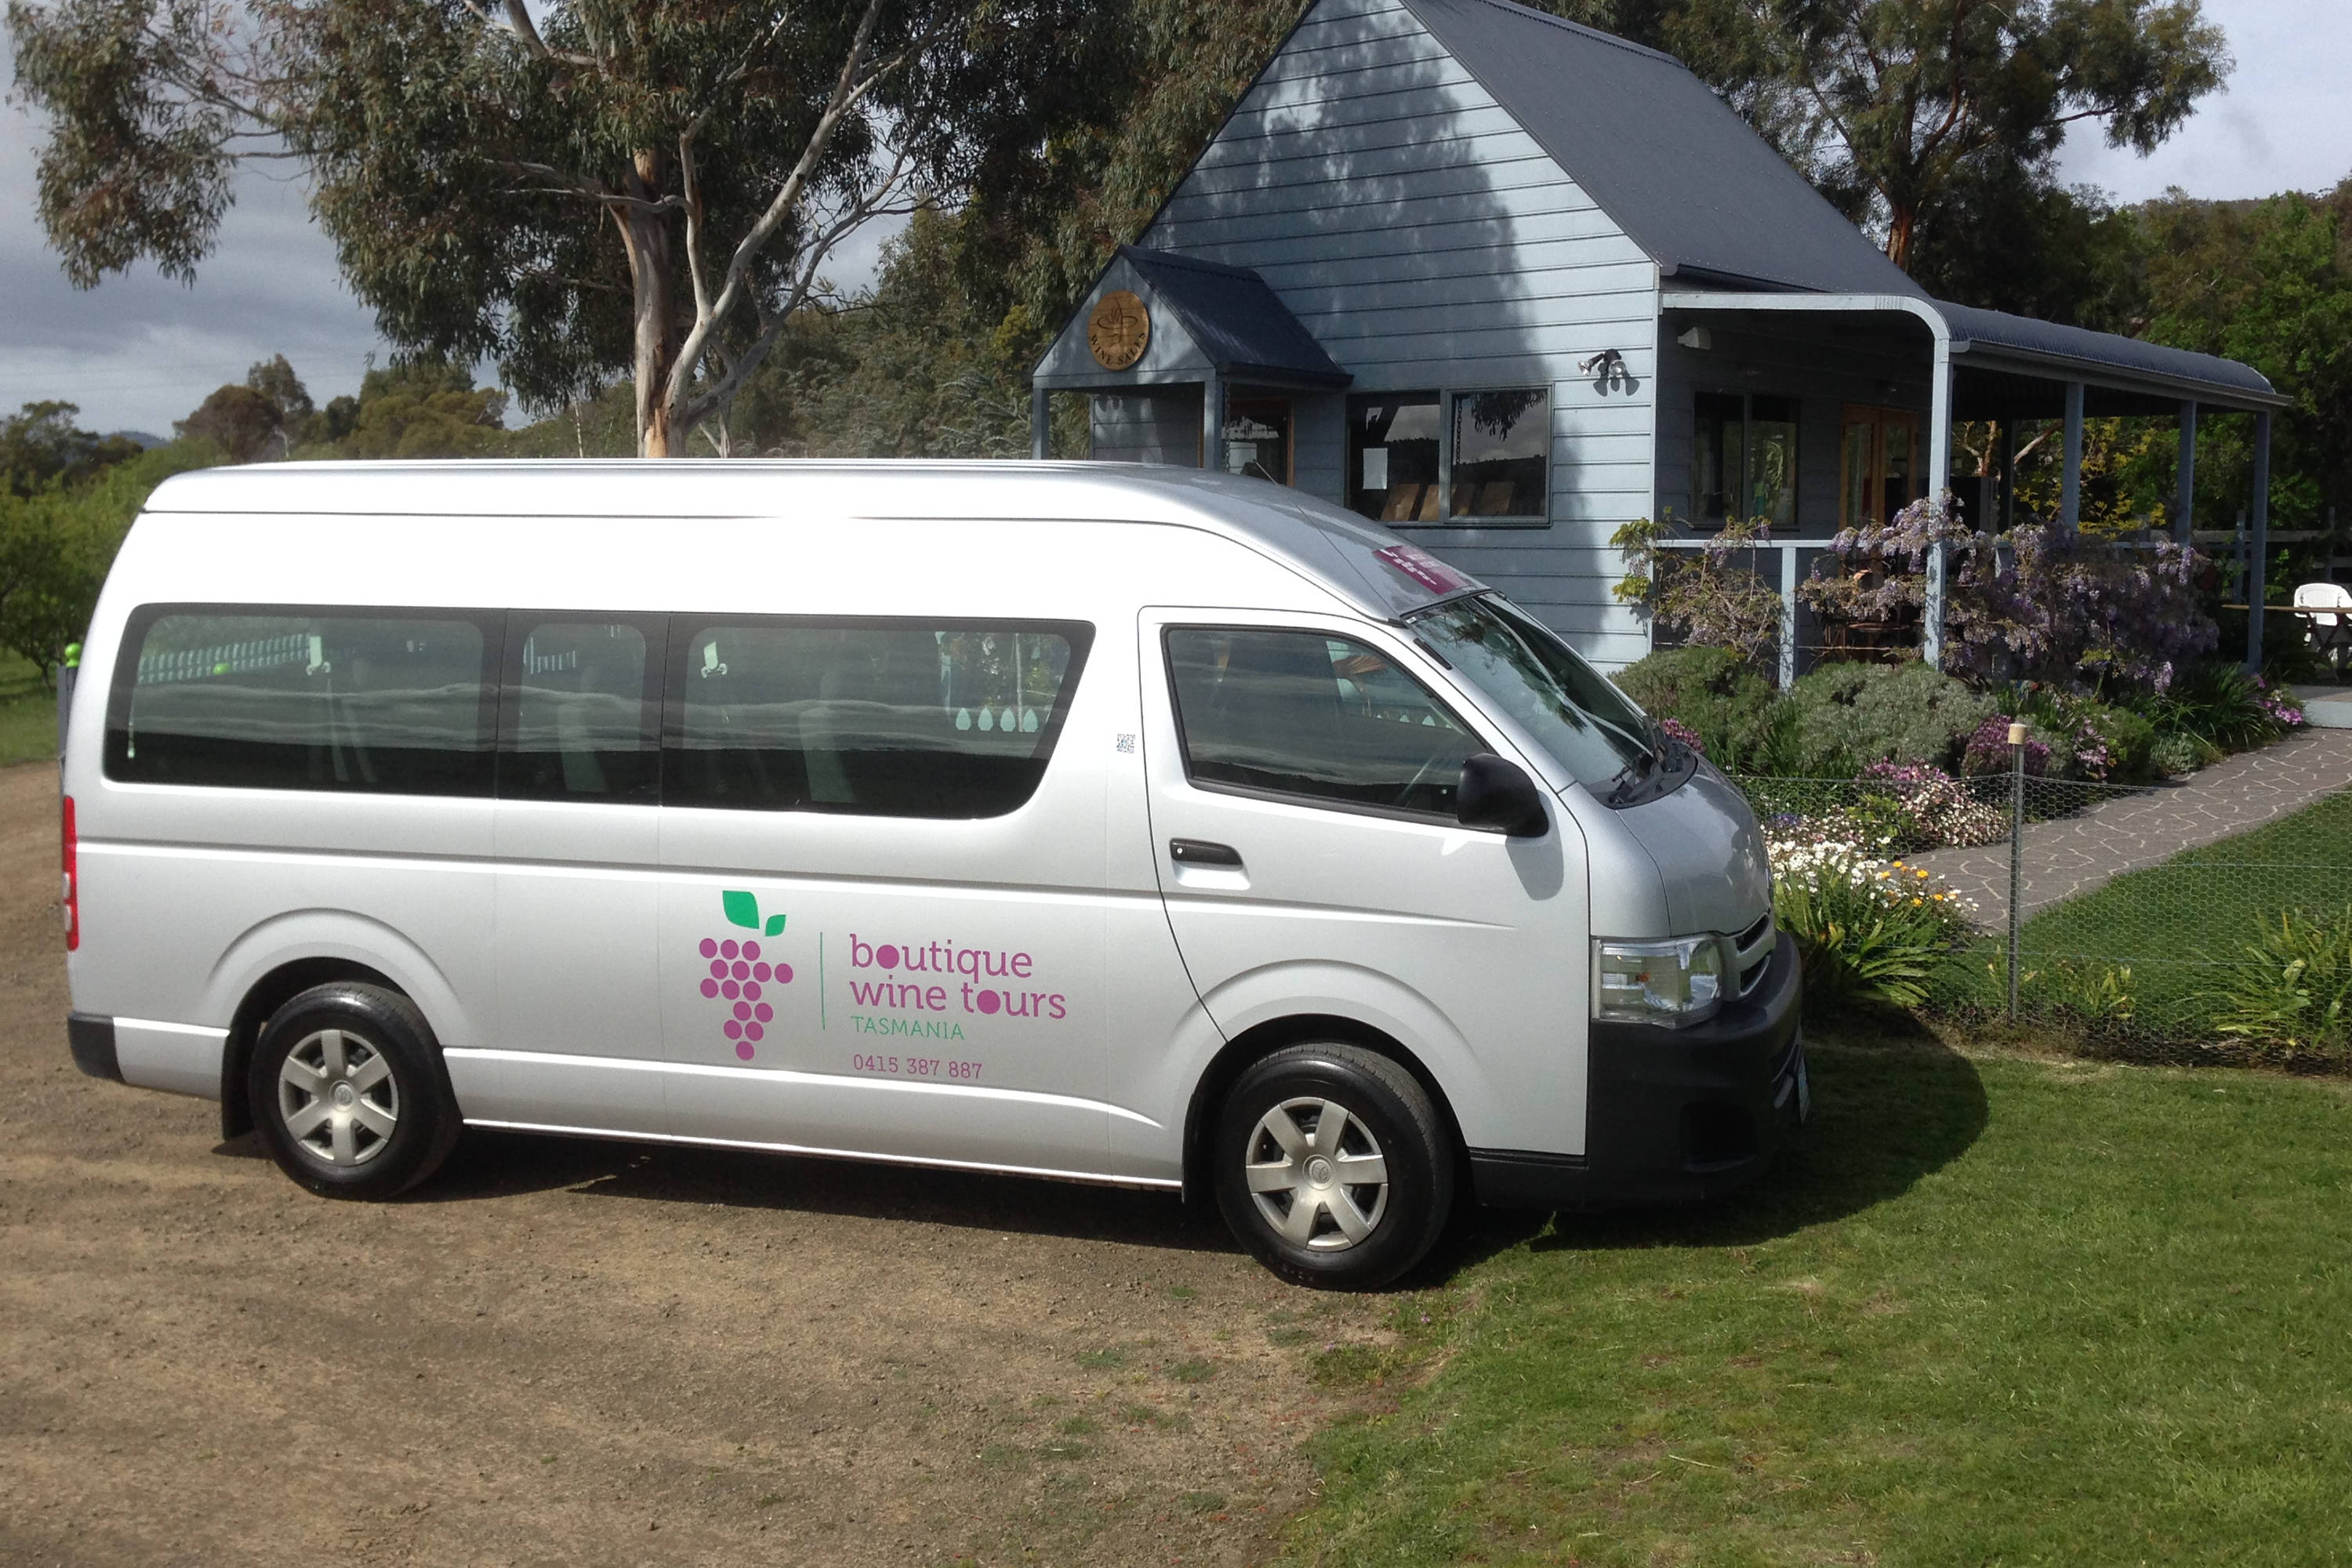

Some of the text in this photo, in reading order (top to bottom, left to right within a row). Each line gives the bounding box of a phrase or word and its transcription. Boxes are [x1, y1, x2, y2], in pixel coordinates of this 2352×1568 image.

[849, 933, 1033, 984] boutique
[850, 975, 1067, 1020] wine tours
[851, 1015, 964, 1040] TASMANIA
[853, 1054, 983, 1080] 0415 387 887
